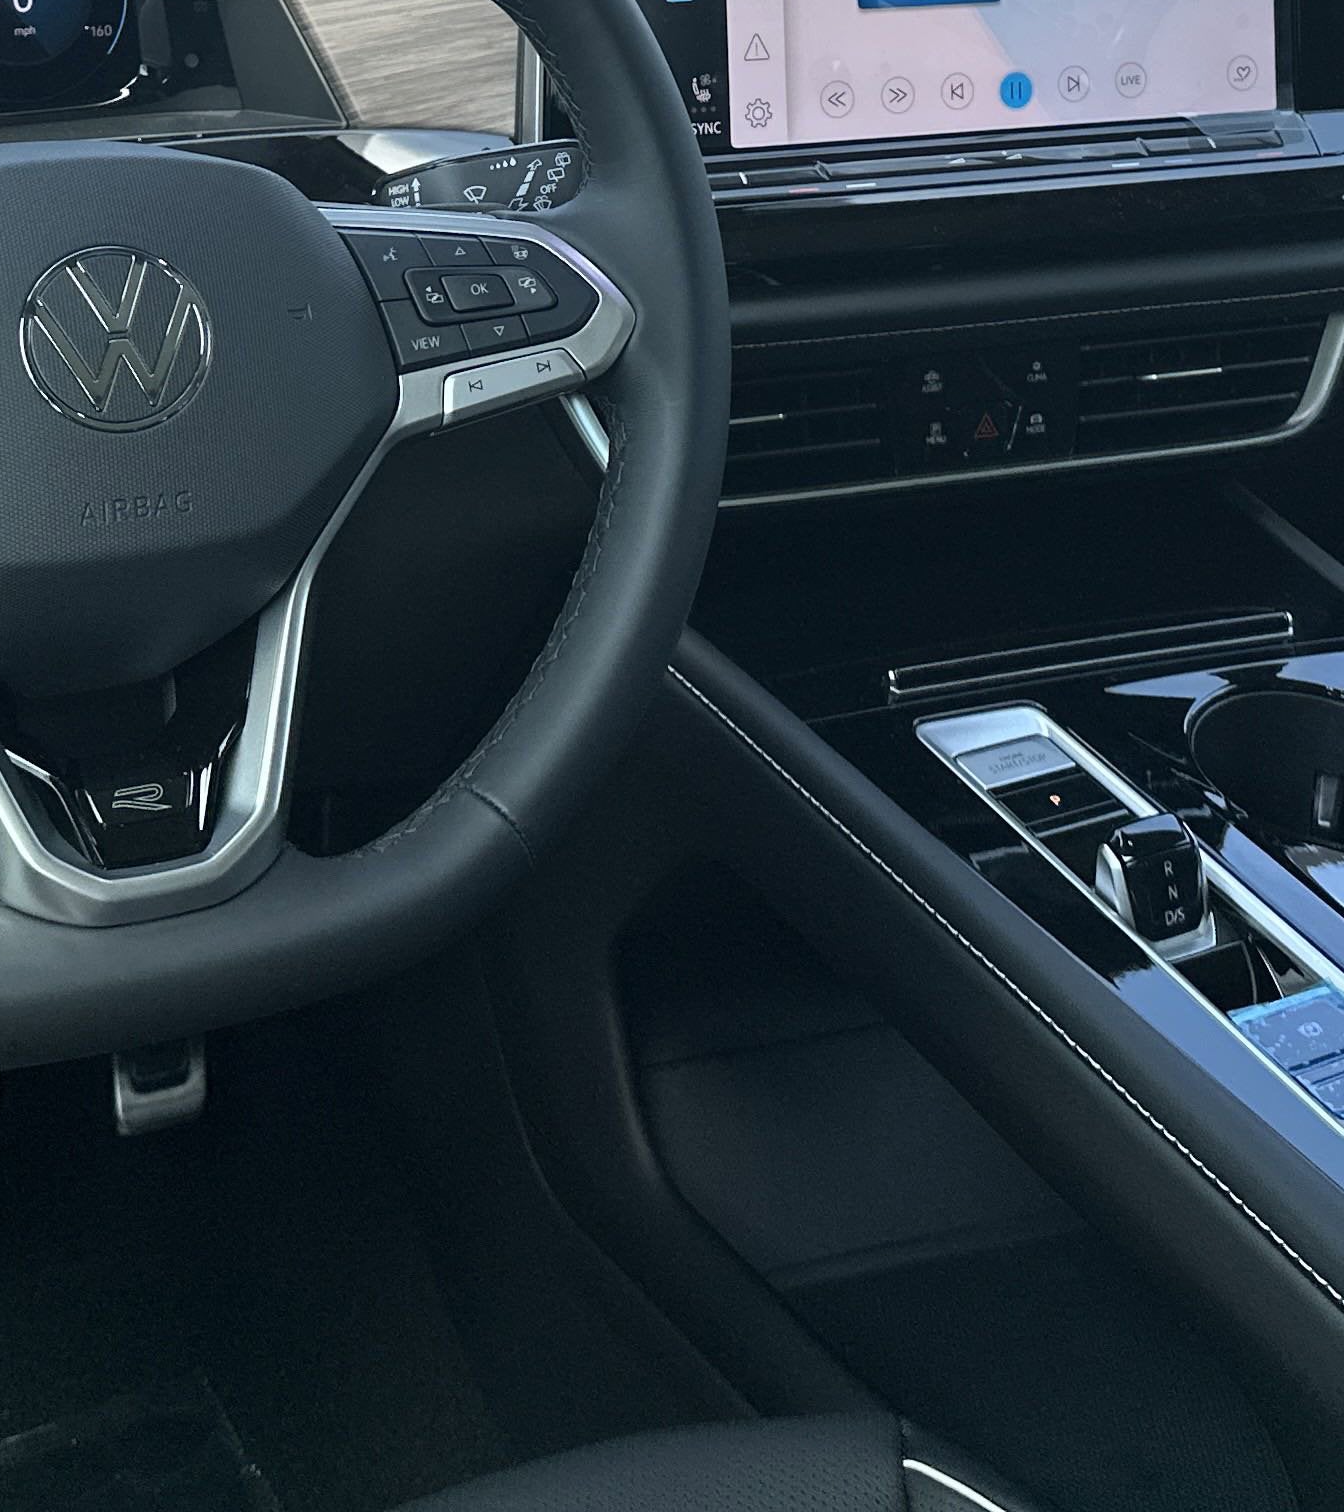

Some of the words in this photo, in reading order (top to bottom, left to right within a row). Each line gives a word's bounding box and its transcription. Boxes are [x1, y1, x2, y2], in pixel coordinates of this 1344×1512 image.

[14, 25, 37, 37] mph
[91, 25, 113, 37] 160
[1120, 74, 1141, 86] LIVE
[689, 120, 722, 136] SYNC
[388, 183, 410, 196] HIGH
[540, 182, 557, 195] OFF
[391, 196, 410, 208] LOW
[470, 284, 490, 296] OK
[411, 336, 441, 351] VIEW
[80, 491, 193, 526] AIRBAG
[1164, 860, 1173, 877] R
[1168, 884, 1178, 900] N
[1165, 907, 1185, 926] D/S
